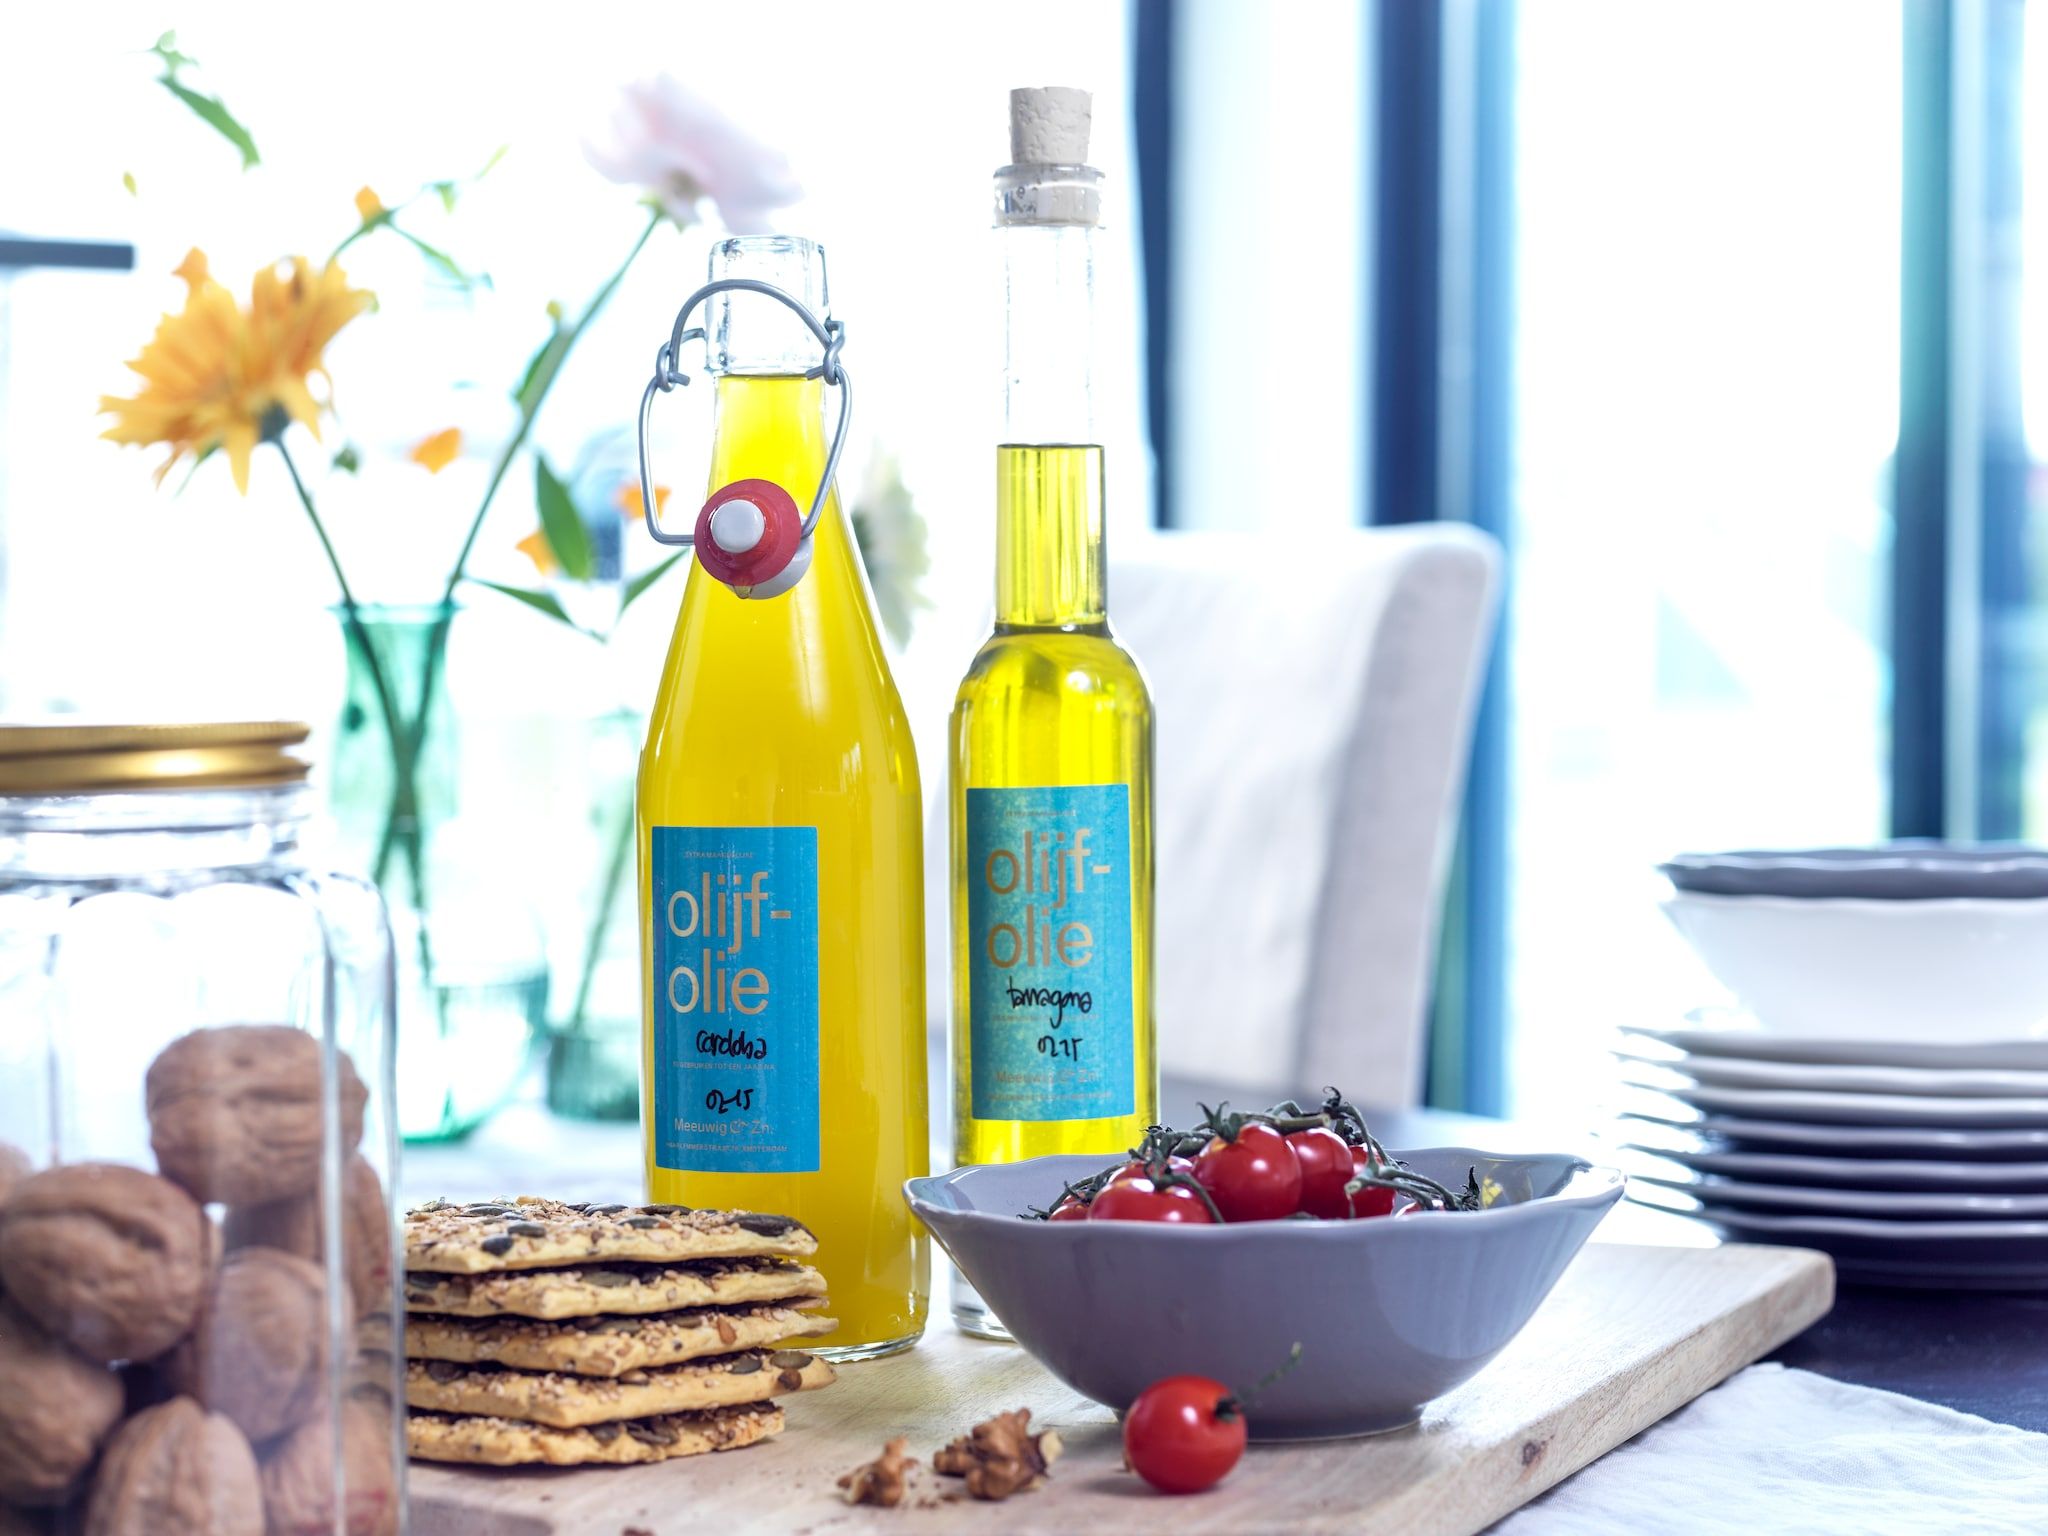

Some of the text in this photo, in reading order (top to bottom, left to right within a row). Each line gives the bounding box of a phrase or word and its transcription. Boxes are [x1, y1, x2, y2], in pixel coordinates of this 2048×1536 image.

[985, 828, 1111, 909] olijf-
[667, 871, 792, 954] olijf-
[987, 904, 1094, 969] olie
[668, 948, 770, 1015] olie
[674, 1117, 727, 1137] Meeuwig
